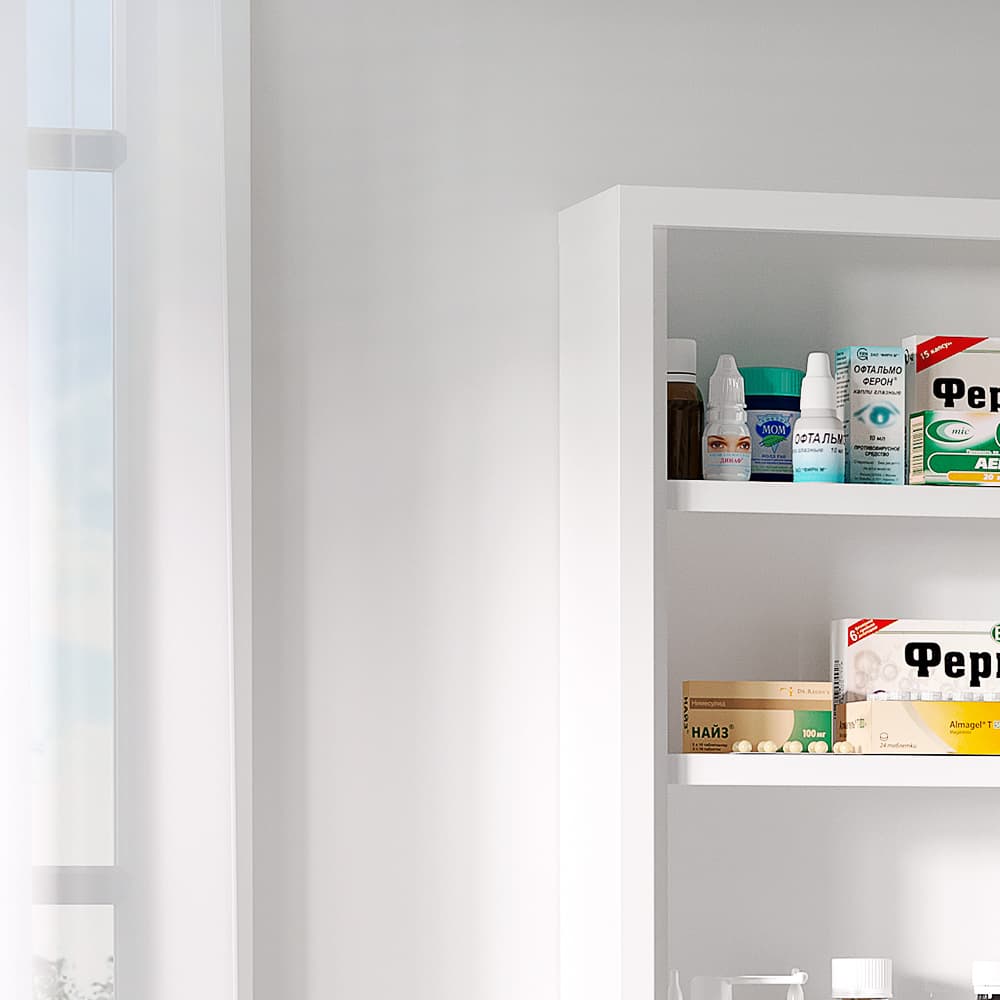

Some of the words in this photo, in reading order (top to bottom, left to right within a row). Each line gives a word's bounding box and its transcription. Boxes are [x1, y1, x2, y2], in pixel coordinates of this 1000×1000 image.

[853, 365, 903, 375] ОФТАЛЬМО
[862, 377, 894, 387] ФЕРОН
[761, 424, 787, 435] МОМ
[951, 426, 970, 435] mic
[849, 629, 858, 642] 6
[691, 722, 729, 739] НАЙЗ
[802, 729, 817, 738] 100
